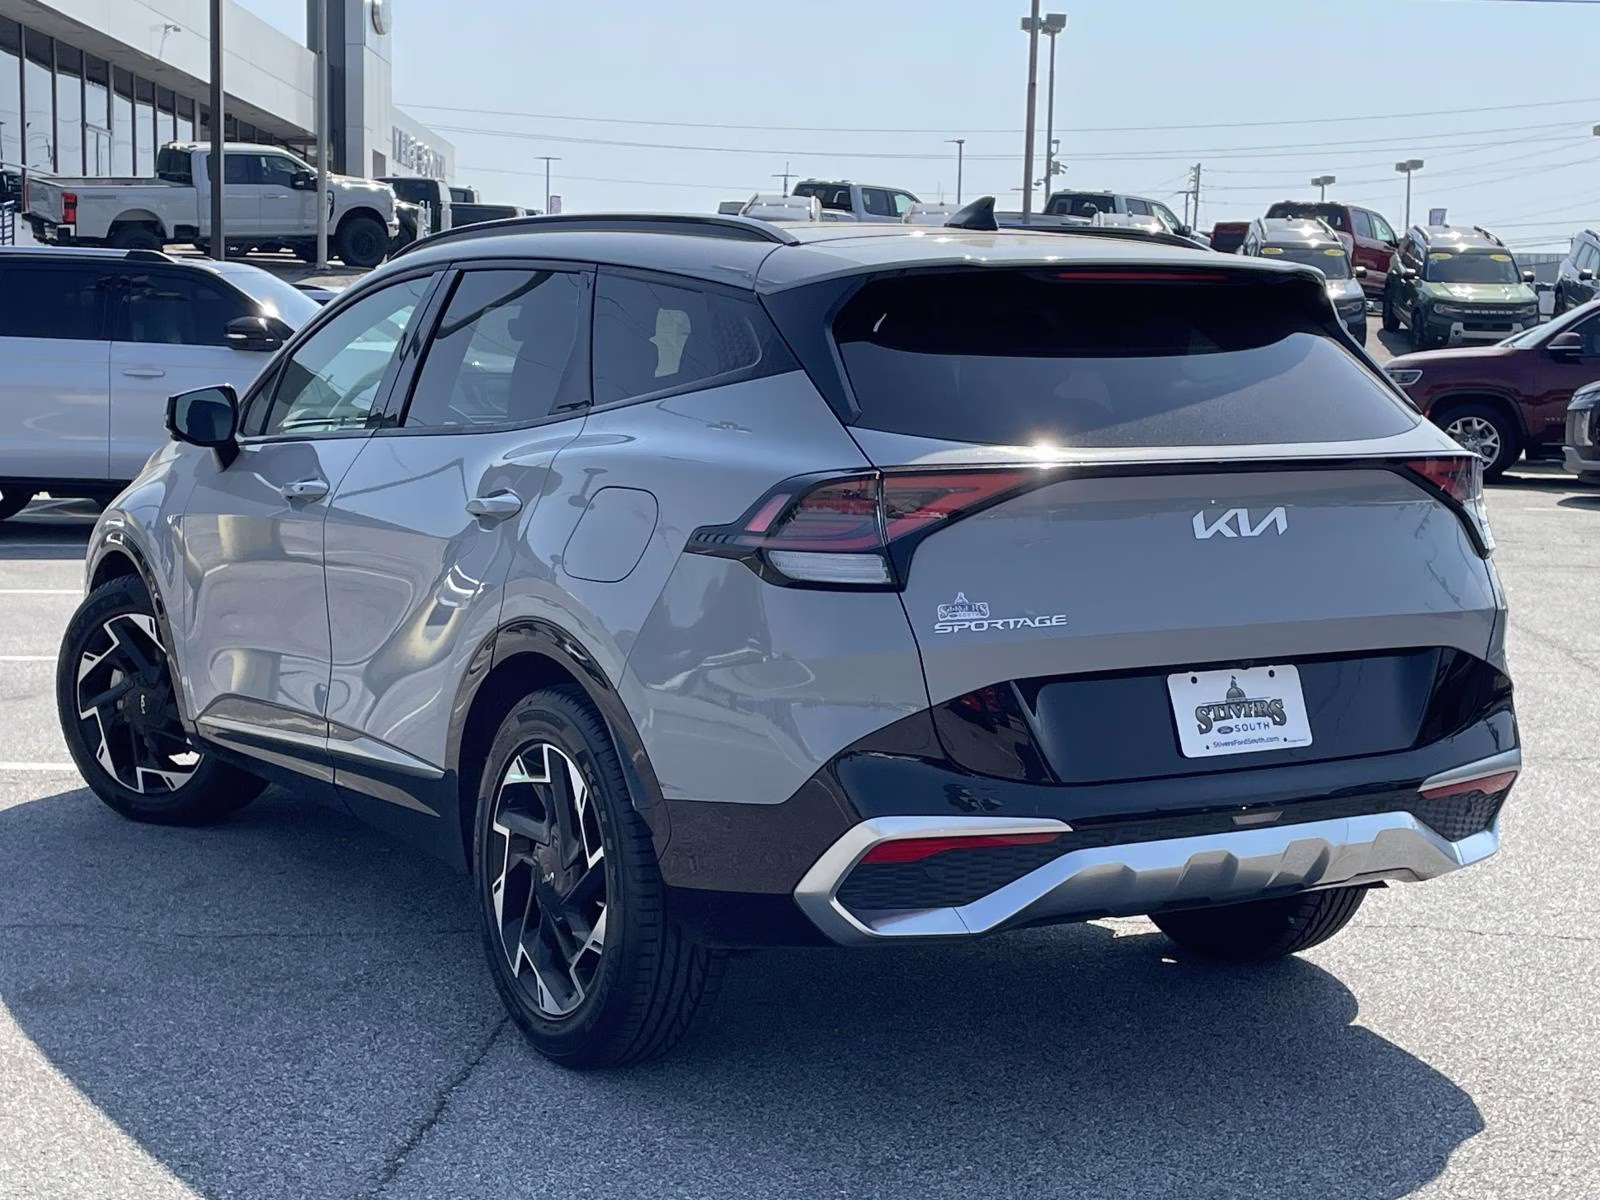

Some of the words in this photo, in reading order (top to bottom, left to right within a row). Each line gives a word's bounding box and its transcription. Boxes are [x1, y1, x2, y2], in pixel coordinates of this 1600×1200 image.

[1192, 507, 1288, 539] KIA
[935, 615, 1067, 634] SPORTAGE
[1195, 699, 1287, 735] STIVERS
[1235, 722, 1270, 732] SOUTH
[1213, 736, 1280, 748] StiversFordSouth.com
